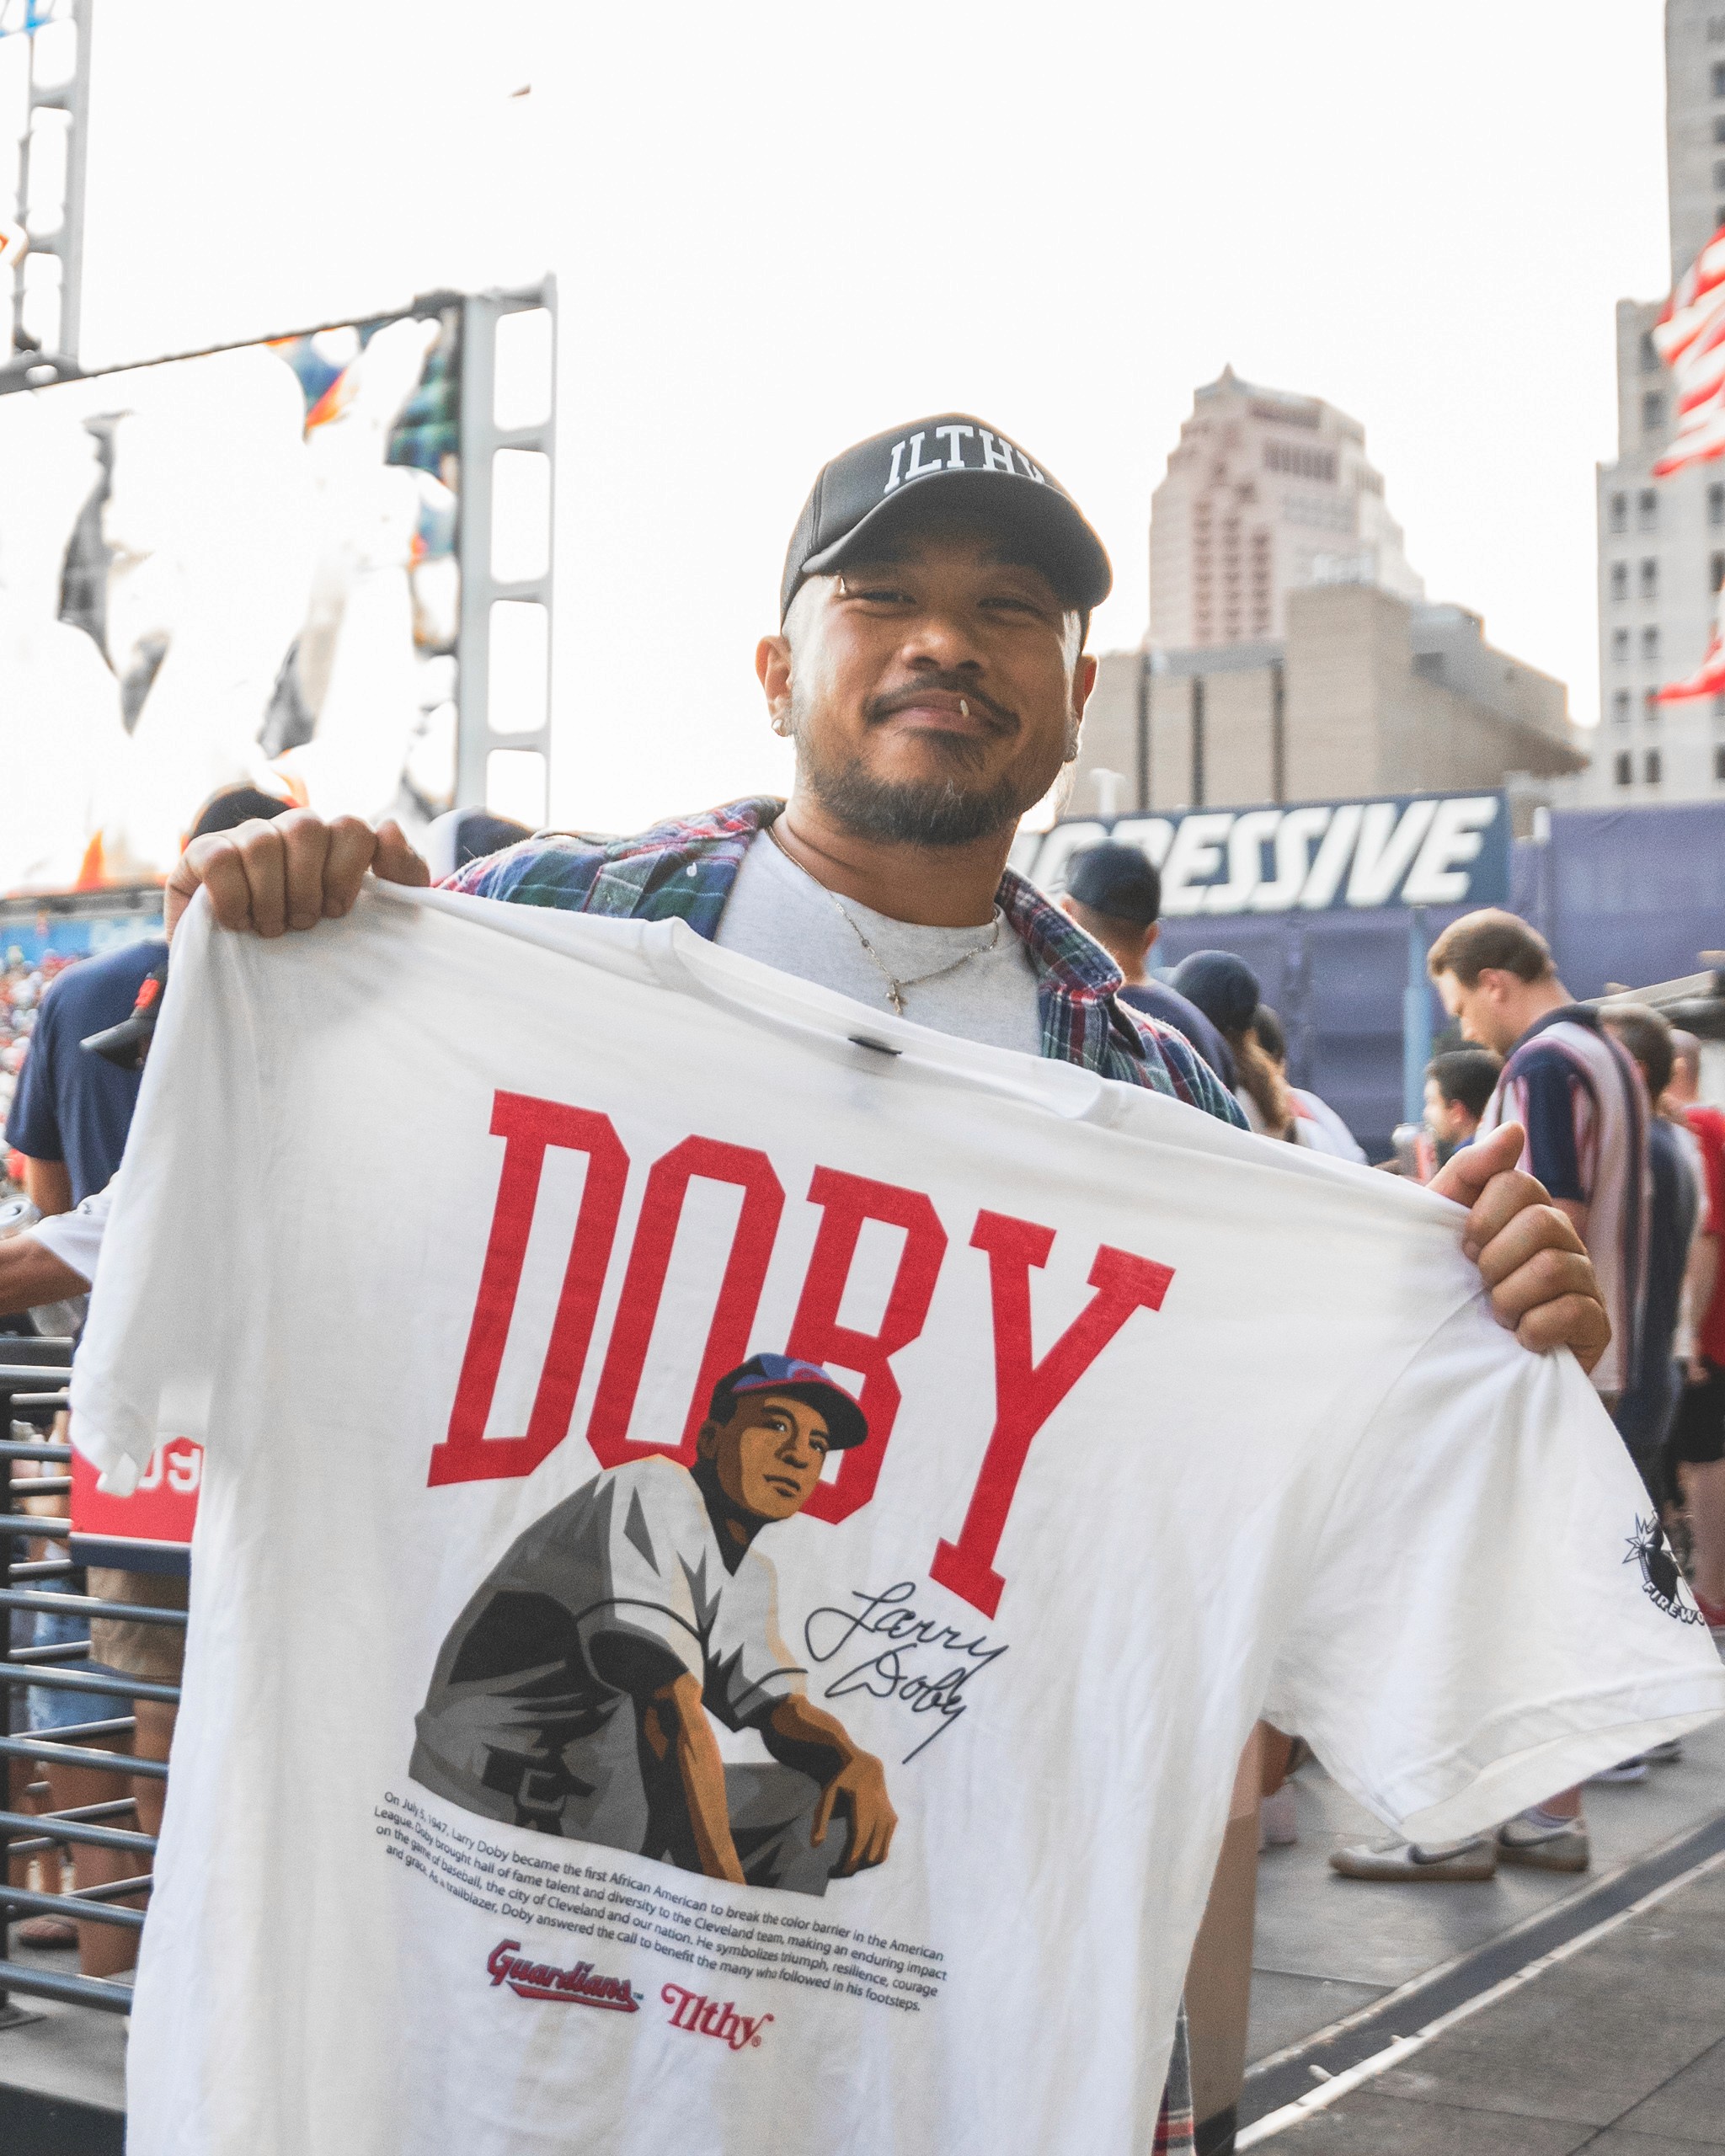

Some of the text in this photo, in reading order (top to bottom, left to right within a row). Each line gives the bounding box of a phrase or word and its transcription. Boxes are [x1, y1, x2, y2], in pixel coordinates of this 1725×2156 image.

[427, 1088, 1176, 1620] DOBY
[805, 1581, 1010, 1701] Larry
[376, 1826, 938, 1998] on the game of baseball, the city of Cleveland and our nation. He symbolizes triumph, resilience, courage
[385, 1791, 399, 1806] On
[451, 1828, 474, 1850] Larry
[477, 1840, 510, 1861] Doby
[511, 1850, 561, 1872] became
[563, 1862, 582, 1876] the
[585, 1866, 607, 1881] first
[609, 1872, 651, 1893] African
[653, 1885, 708, 1912] American
[710, 1904, 724, 1915] to
[726, 1905, 760, 1922] break
[762, 1912, 779, 1925] the
[781, 1916, 810, 1929] color
[812, 1920, 851, 1938] barrier
[852, 1929, 864, 1942] in
[868, 1934, 887, 1949] the
[889, 1940, 943, 1961] American
[386, 1844, 404, 1860] and
[429, 1870, 438, 1883] As
[446, 1881, 498, 1913] trailblazer,
[501, 1903, 534, 1924] Doby
[537, 1913, 595, 1935] answered
[597, 1925, 615, 1940] the
[617, 1932, 638, 1944] call
[640, 1936, 652, 1948] to
[654, 1940, 695, 1963] benefit
[697, 1955, 718, 1970] the
[718, 1961, 754, 1979] many
[756, 1967, 777, 1979] who
[778, 1967, 831, 1988] followed
[832, 1979, 844, 1992] in
[846, 1981, 863, 1996] his
[865, 1987, 921, 2012] footsteps.
[435, 1837, 472, 1865] brought
[473, 1857, 495, 1874] hall
[497, 1867, 512, 1878] of
[512, 1869, 542, 1886] fame
[546, 1877, 581, 1895] talent
[583, 1886, 606, 1900] and
[607, 1890, 657, 1916] diversity
[659, 1906, 670, 1919] to
[672, 1911, 692, 1926] the
[695, 1917, 755, 1940] Cleveland
[788, 1936, 832, 1956] making
[834, 1945, 848, 1956] an
[851, 1949, 905, 1973] enduring
[906, 1961, 947, 1981] impact
[487, 1938, 637, 2010] Guardians
